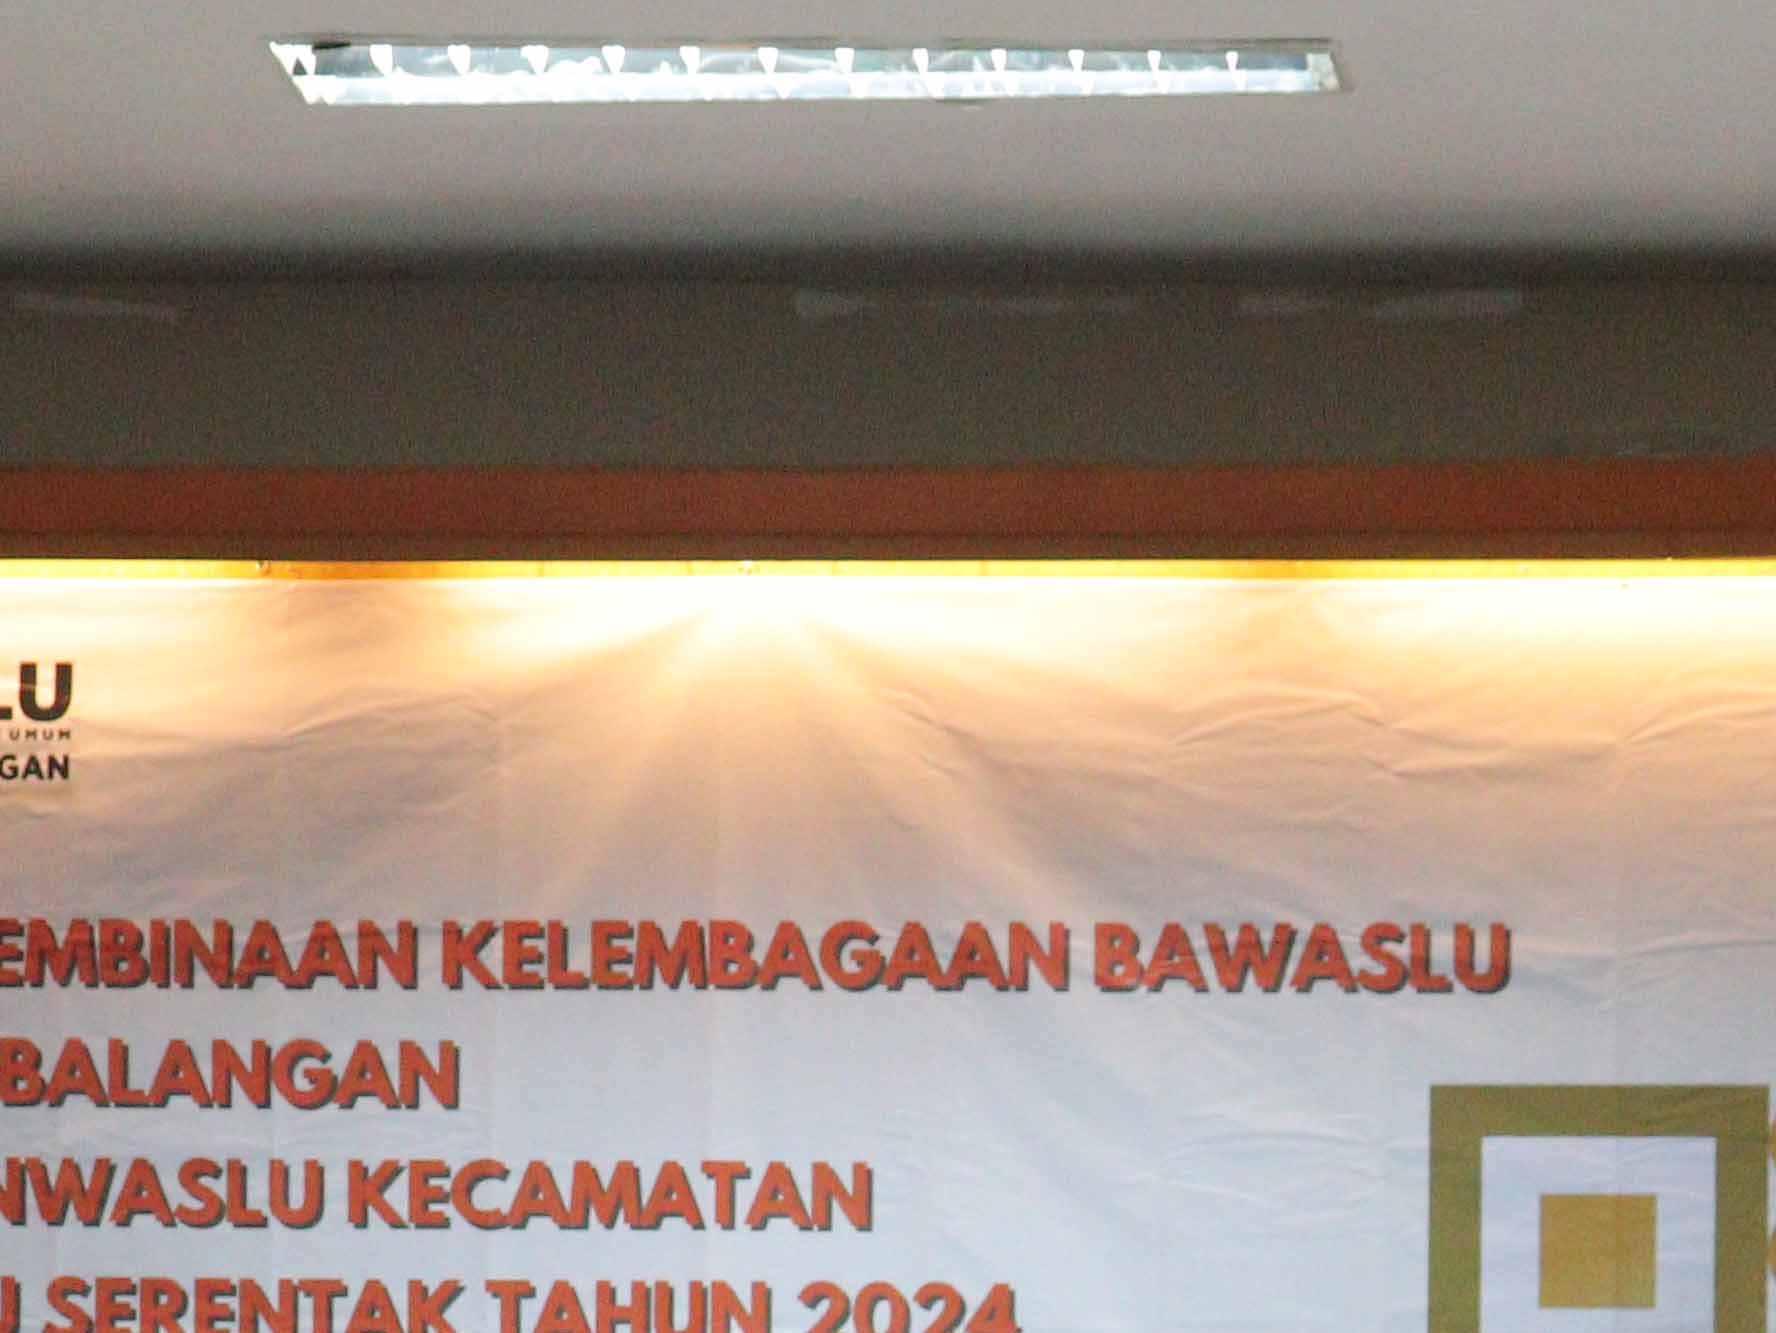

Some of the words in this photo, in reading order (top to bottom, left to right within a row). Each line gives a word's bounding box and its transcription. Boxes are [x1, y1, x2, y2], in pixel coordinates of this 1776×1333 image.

[8, 728, 72, 742] UMUM
[441, 918, 1070, 991] KELEMBAGAAN
[1095, 921, 1511, 992] BAWASLU
[348, 1159, 873, 1231] KECAMATAN
